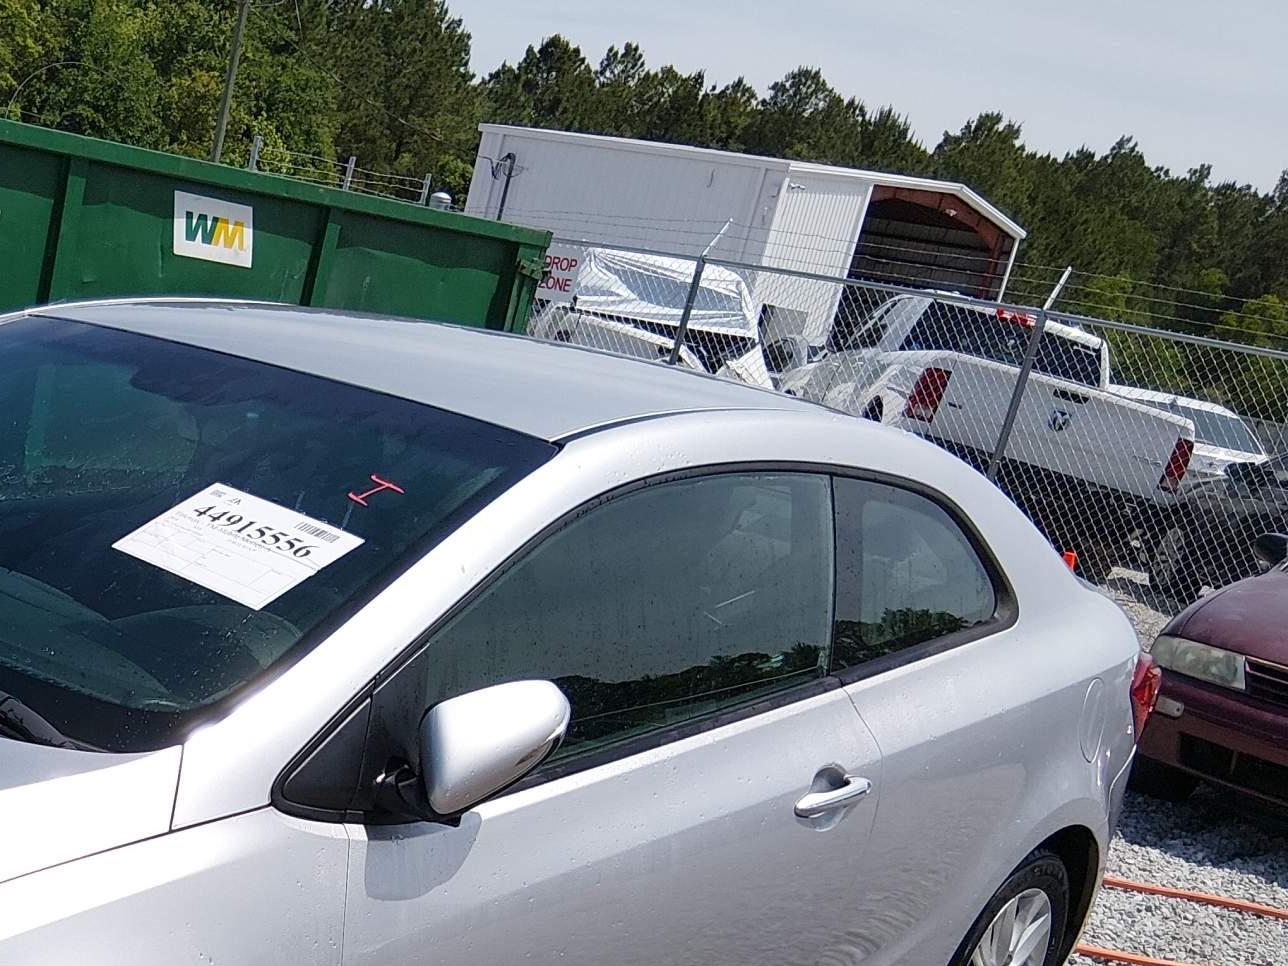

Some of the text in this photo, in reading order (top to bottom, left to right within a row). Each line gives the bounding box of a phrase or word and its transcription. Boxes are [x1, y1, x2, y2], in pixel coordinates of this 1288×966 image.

[185, 211, 245, 252] WM
[544, 255, 578, 272] DROP
[193, 504, 321, 559] 44915556
